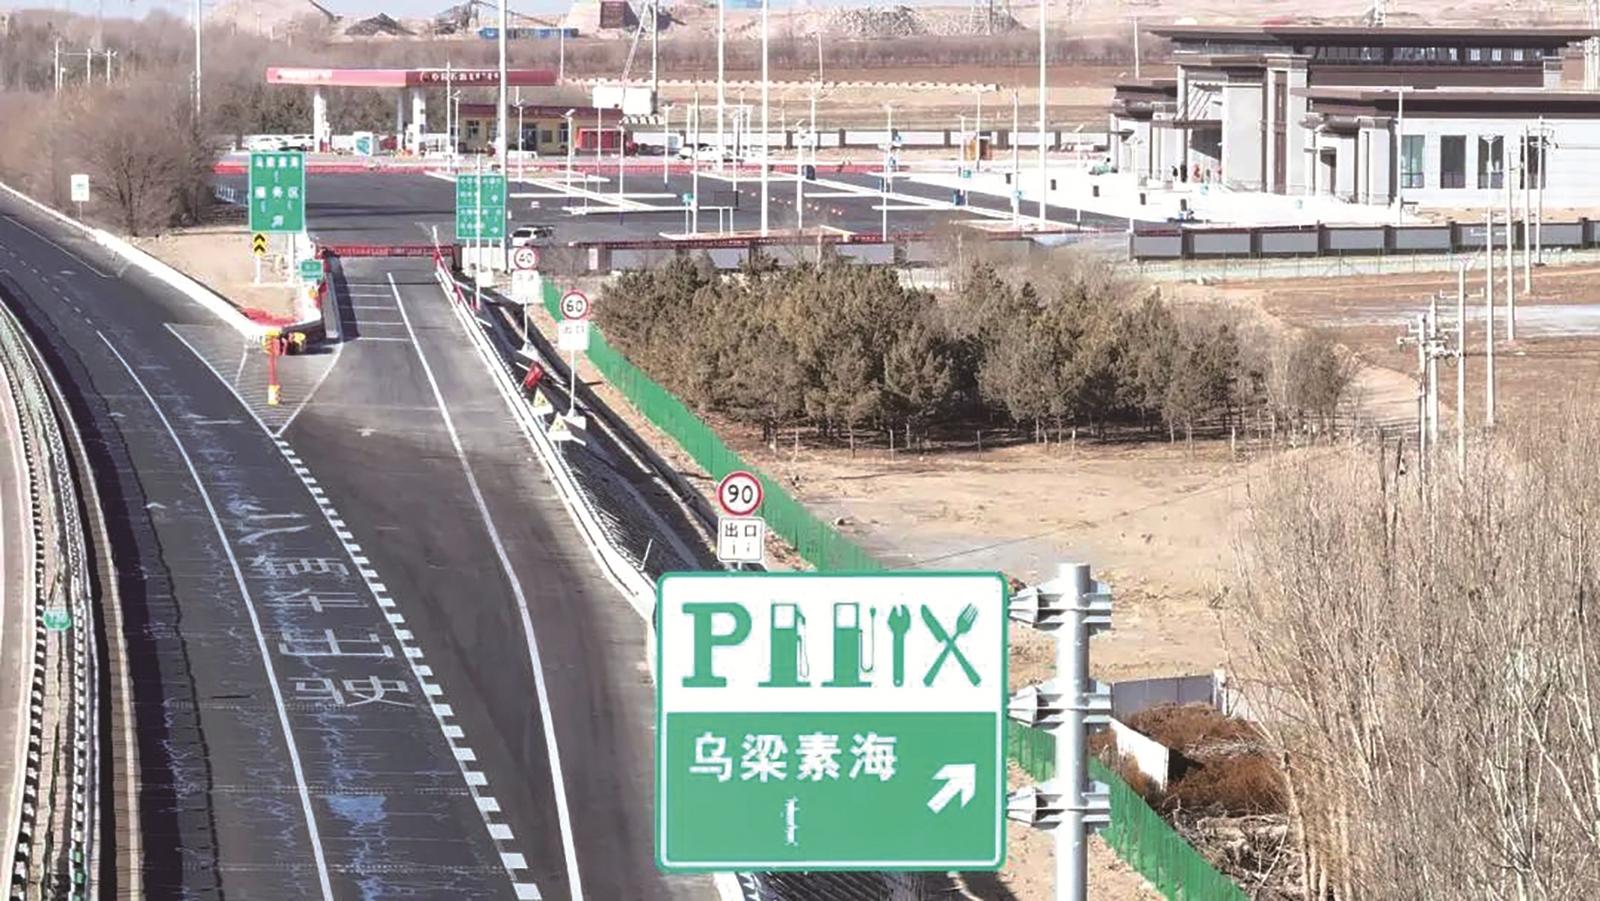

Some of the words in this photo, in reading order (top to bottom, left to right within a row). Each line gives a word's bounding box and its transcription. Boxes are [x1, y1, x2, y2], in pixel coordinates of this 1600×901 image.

[519, 253, 533, 264] 40
[566, 299, 583, 312] 60
[728, 484, 753, 504] 90
[725, 522, 757, 538] 出口
[689, 732, 898, 782] 乌梁素海
